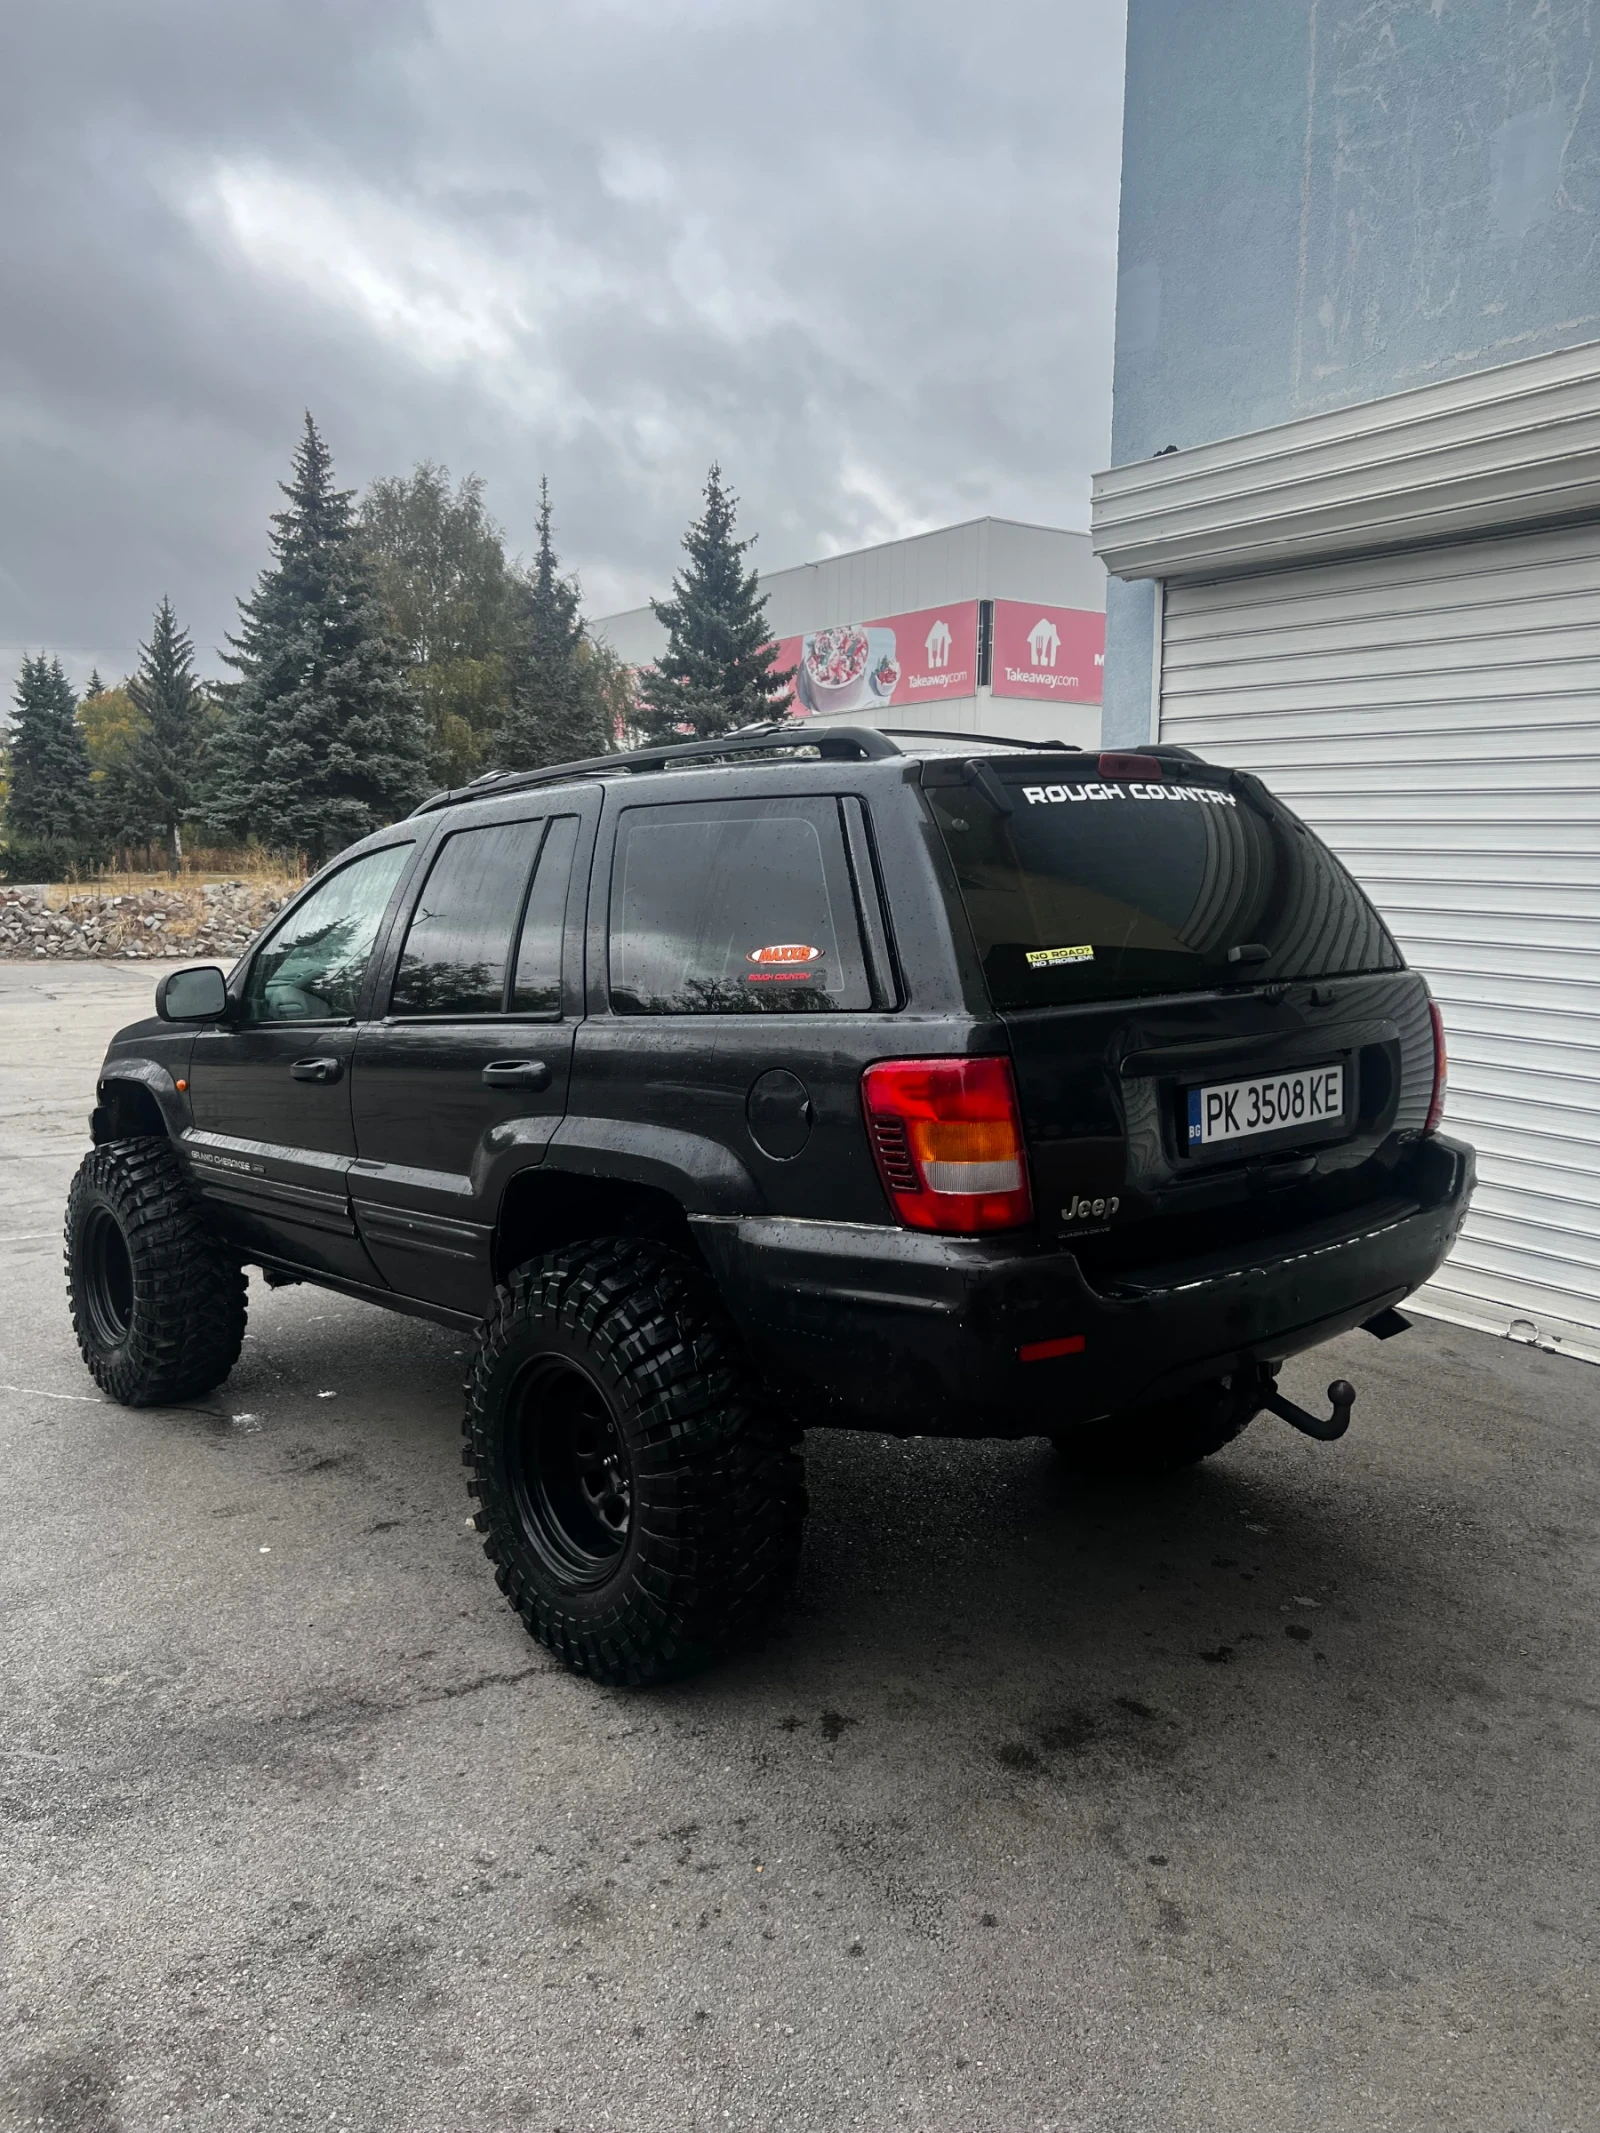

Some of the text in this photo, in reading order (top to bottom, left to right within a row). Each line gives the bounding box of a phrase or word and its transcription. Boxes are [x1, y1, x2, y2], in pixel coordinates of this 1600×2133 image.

[908, 670, 968, 689] Takeaway.com
[1004, 667, 1079, 688] Takeaway.com
[1022, 783, 1237, 807] ROUGH COUNTRY
[758, 946, 811, 961] MAXXIS
[1031, 960, 1047, 968] NO
[774, 972, 811, 980] COUNTRY
[1206, 1072, 1338, 1136] PK 3508 KE
[1189, 1124, 1201, 1138] BG
[191, 1150, 251, 1171] GRAND CHEROKEE
[1061, 1195, 1120, 1220] Jeep
